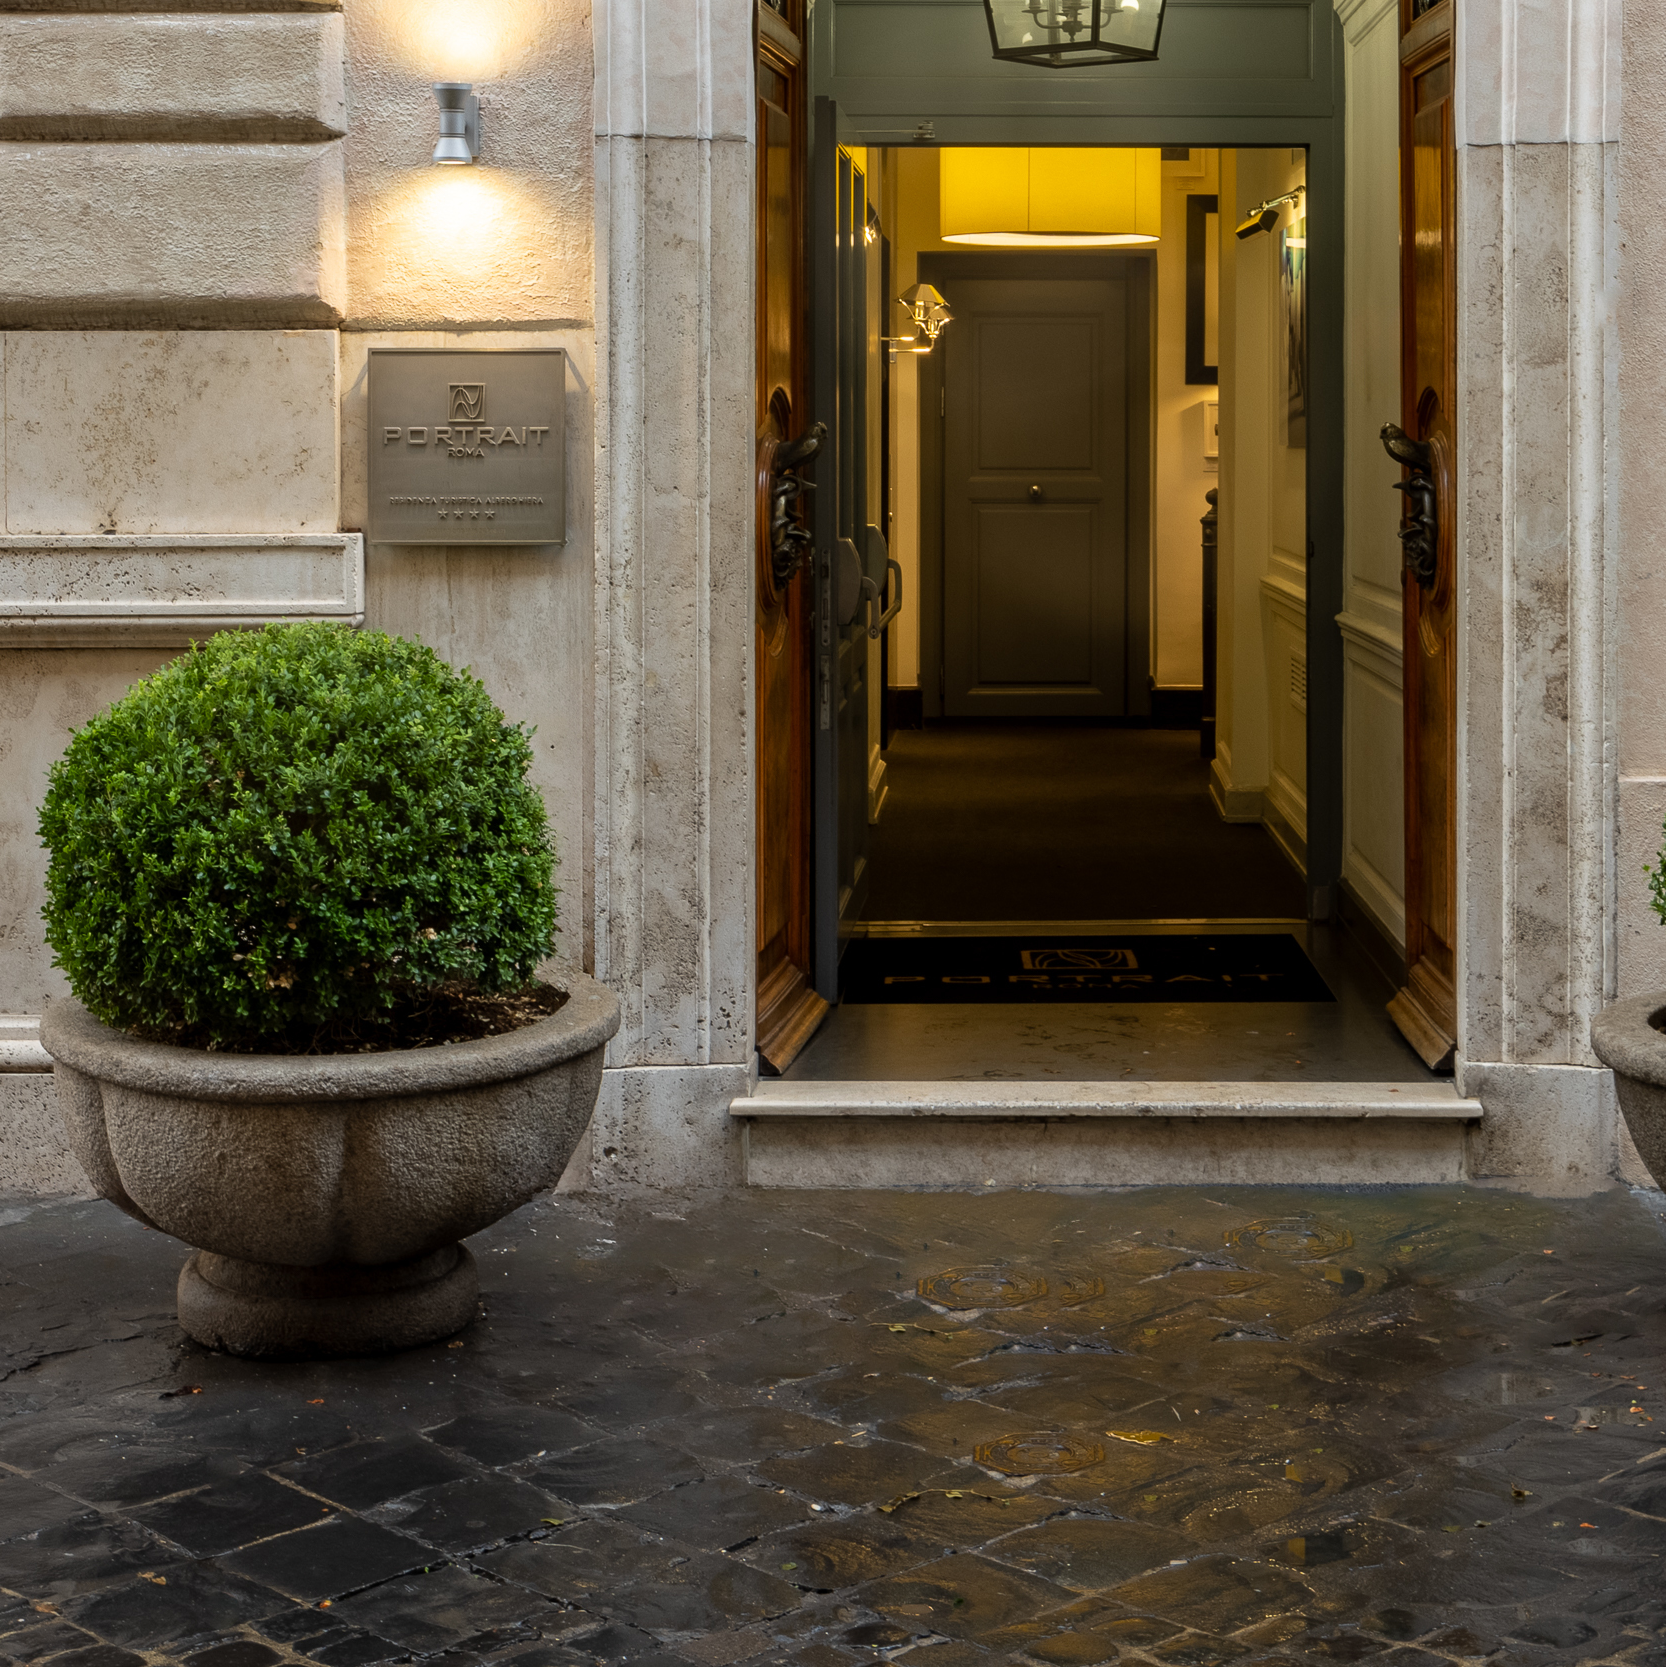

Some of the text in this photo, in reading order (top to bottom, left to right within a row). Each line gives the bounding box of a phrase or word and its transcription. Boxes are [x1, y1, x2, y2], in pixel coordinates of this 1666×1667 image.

[383, 425, 550, 446] PORTRAIT
[447, 447, 485, 458] ROMA
[884, 973, 1285, 987] PORTRAIT
